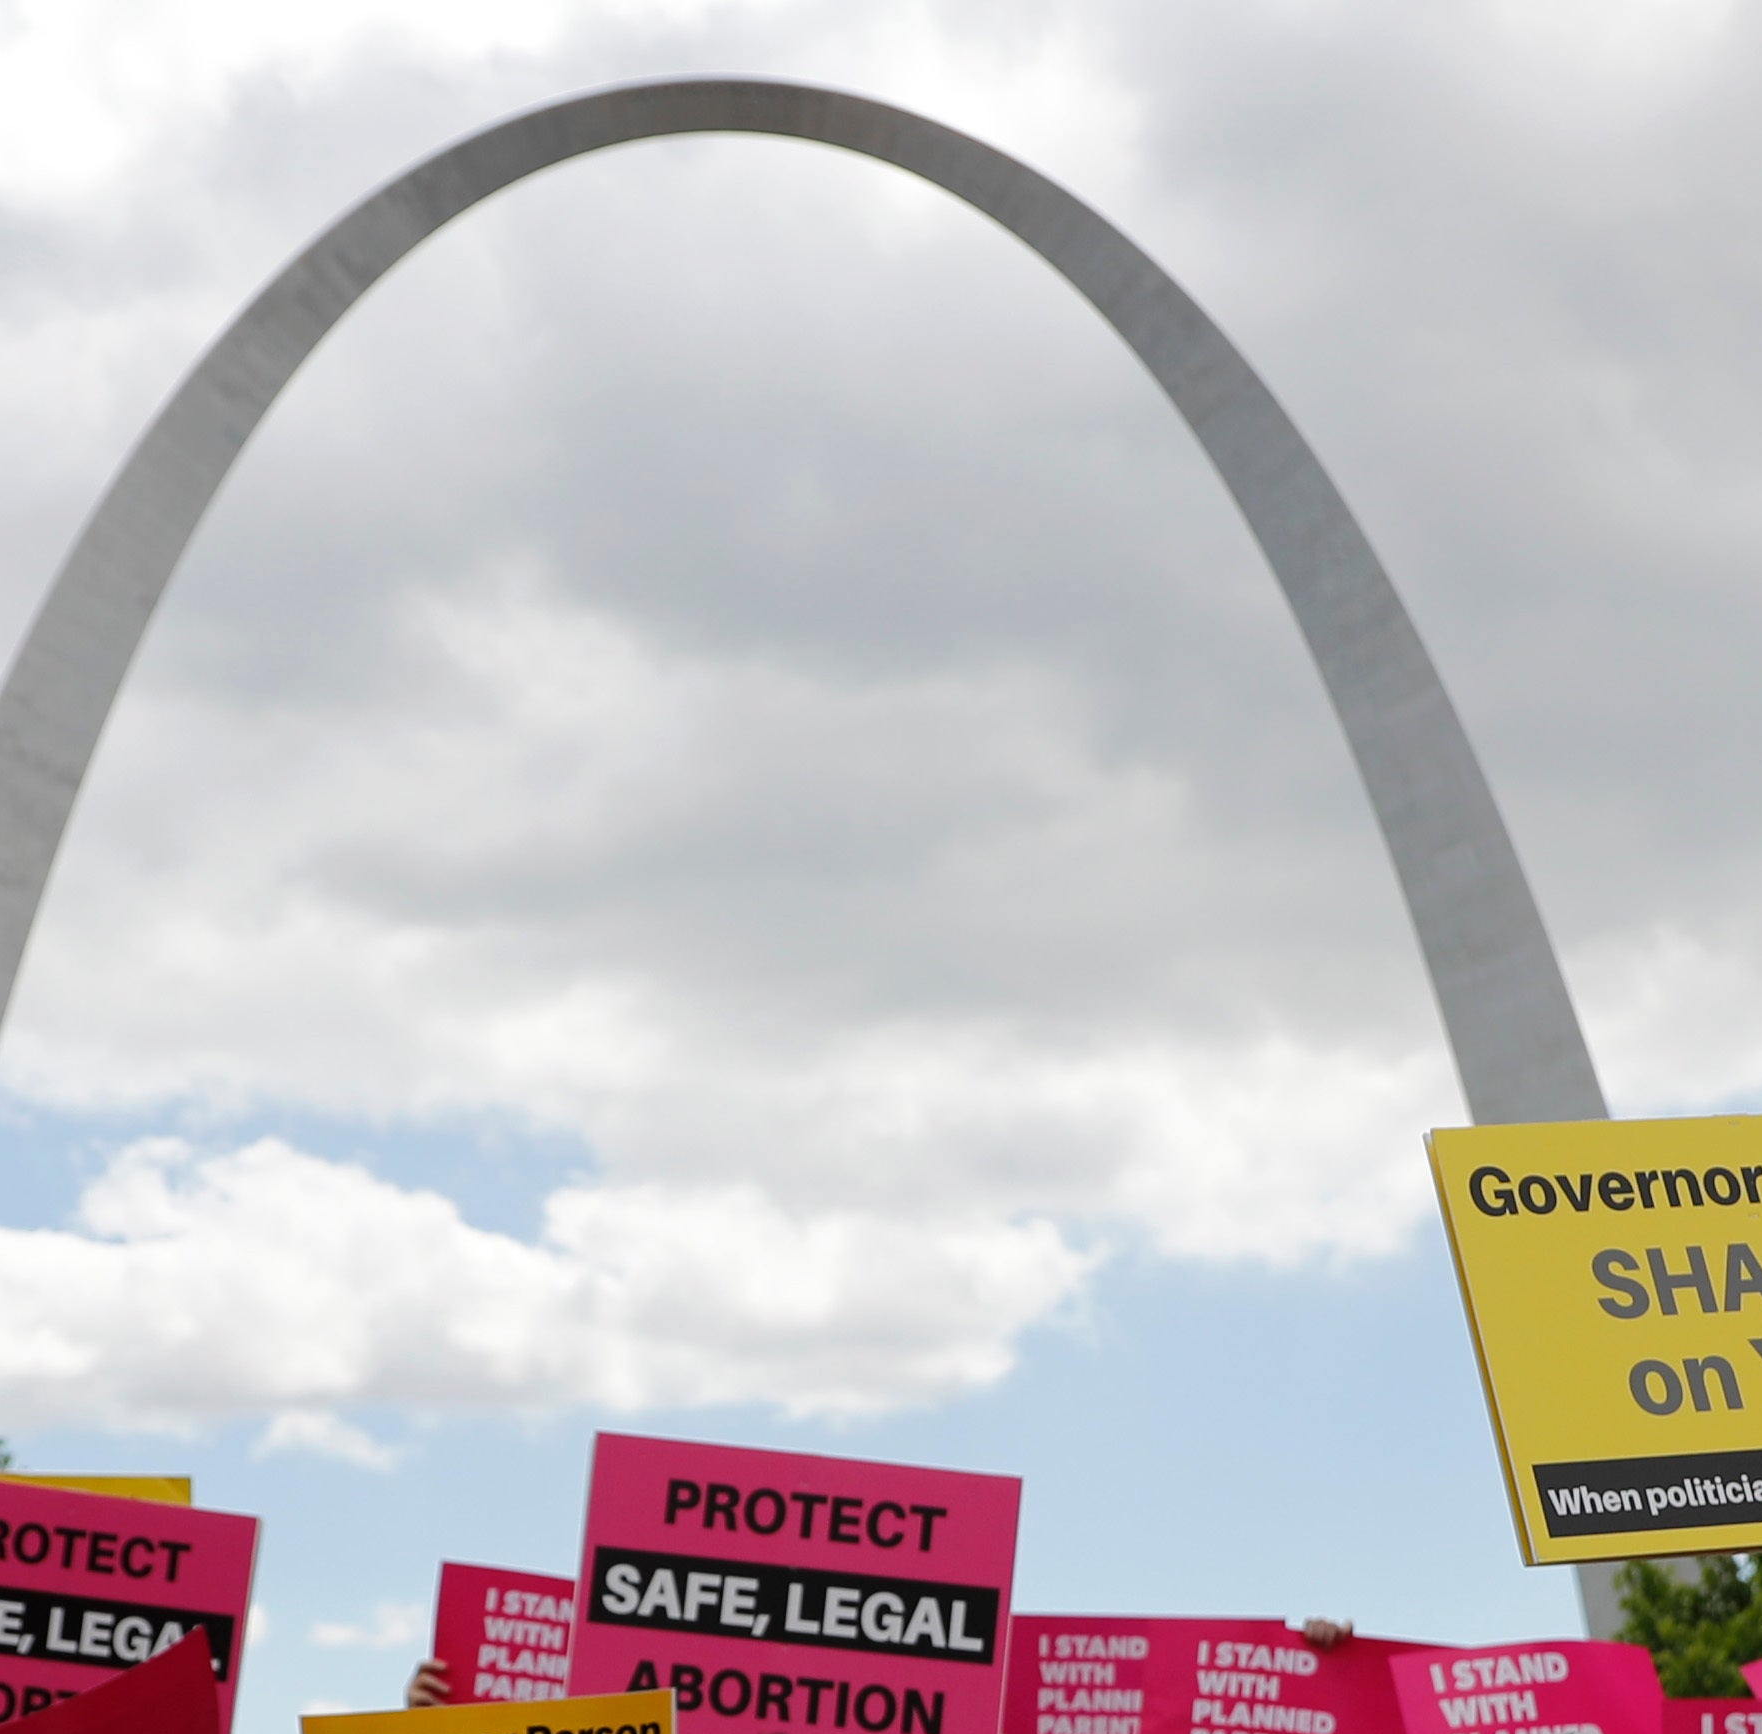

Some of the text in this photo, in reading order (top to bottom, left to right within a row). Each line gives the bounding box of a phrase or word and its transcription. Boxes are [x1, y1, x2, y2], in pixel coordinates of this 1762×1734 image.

[1628, 1354, 1745, 1417] on
[664, 1477, 948, 1553] PROTECT
[1548, 1484, 1645, 1517] When
[484, 1587, 575, 1624] I STAN
[600, 1562, 985, 1652] SAFE, LEGAL
[45, 1606, 222, 1673] LEGA
[483, 1615, 565, 1650] WITH
[1039, 1633, 1148, 1659] I STAND
[477, 1643, 569, 1679] PLANN
[1040, 1661, 1116, 1686] WITH
[1196, 1640, 1319, 1676] I STAND
[1429, 1651, 1570, 1694] I STAND
[1195, 1669, 1280, 1701] WITH
[1437, 1689, 1538, 1729] WITH
